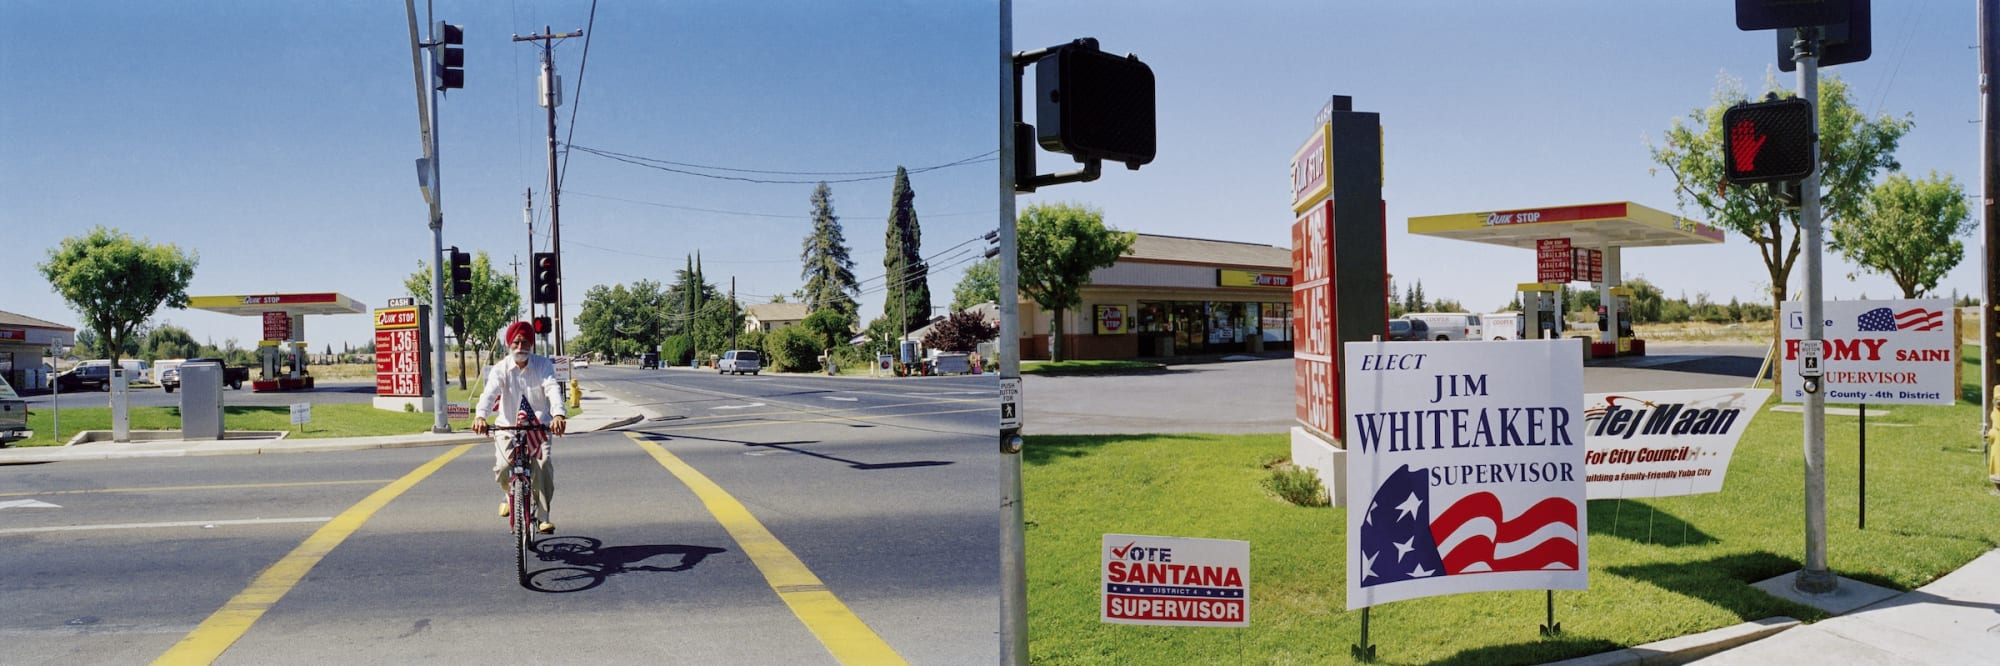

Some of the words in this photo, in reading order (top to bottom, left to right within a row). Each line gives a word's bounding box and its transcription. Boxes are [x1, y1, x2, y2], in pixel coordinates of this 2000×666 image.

[1516, 212, 1540, 223] STOP
[1302, 209, 1323, 282] 1.36
[264, 296, 280, 304] STOP
[389, 299, 409, 307] CASH
[398, 312, 415, 323] STOP
[1303, 286, 1325, 354] 1.45
[391, 331, 412, 352] 1.36
[391, 352, 413, 373] 1.45
[1361, 354, 1427, 371] ELECT
[1896, 350, 1950, 362] SAINI
[392, 374, 414, 395] 1.55
[1430, 374, 1489, 403] JIM
[1826, 372, 1918, 385] UPERVISOR
[1304, 360, 1327, 431] 1.55
[1830, 391, 1866, 400] County
[1875, 391, 1893, 399] 4th
[1899, 391, 1940, 400] District
[1355, 407, 1573, 454] WHITEAKER
[1594, 404, 1647, 439] Tej
[1641, 403, 1740, 436] Maan
[1585, 450, 1608, 465] For
[1608, 448, 1636, 465] City
[1637, 446, 1690, 463] Council
[1431, 462, 1575, 487] SUPERVISOR
[1585, 472, 1613, 482] uilding
[1697, 468, 1712, 476] City
[1108, 561, 1243, 587] SANTANA
[1111, 598, 1240, 620] SUPERVISOR
